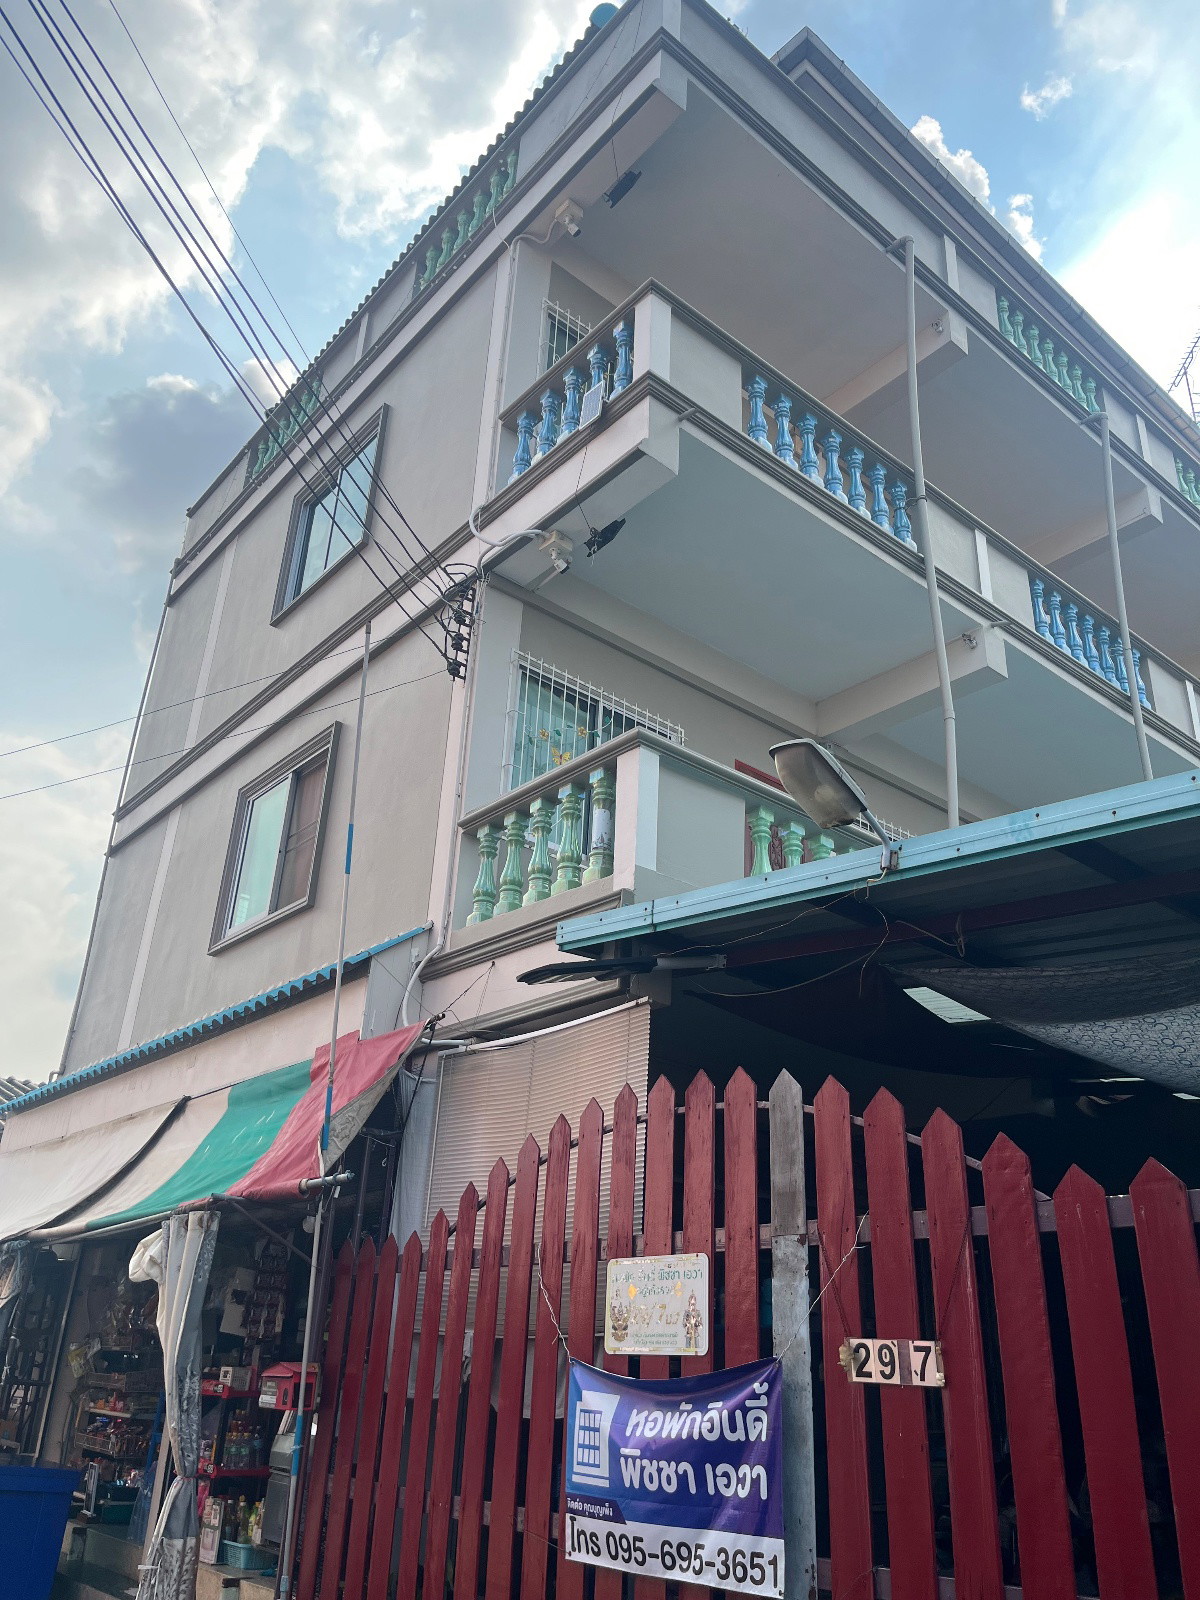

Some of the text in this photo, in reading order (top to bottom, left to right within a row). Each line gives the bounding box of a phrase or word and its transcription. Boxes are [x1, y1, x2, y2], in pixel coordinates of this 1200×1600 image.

[625, 1382, 769, 1442] หอพักอินดี้
[620, 1447, 768, 1501] พิชชา เอวา
[569, 1516, 779, 1589] โทร 095-695-3651
